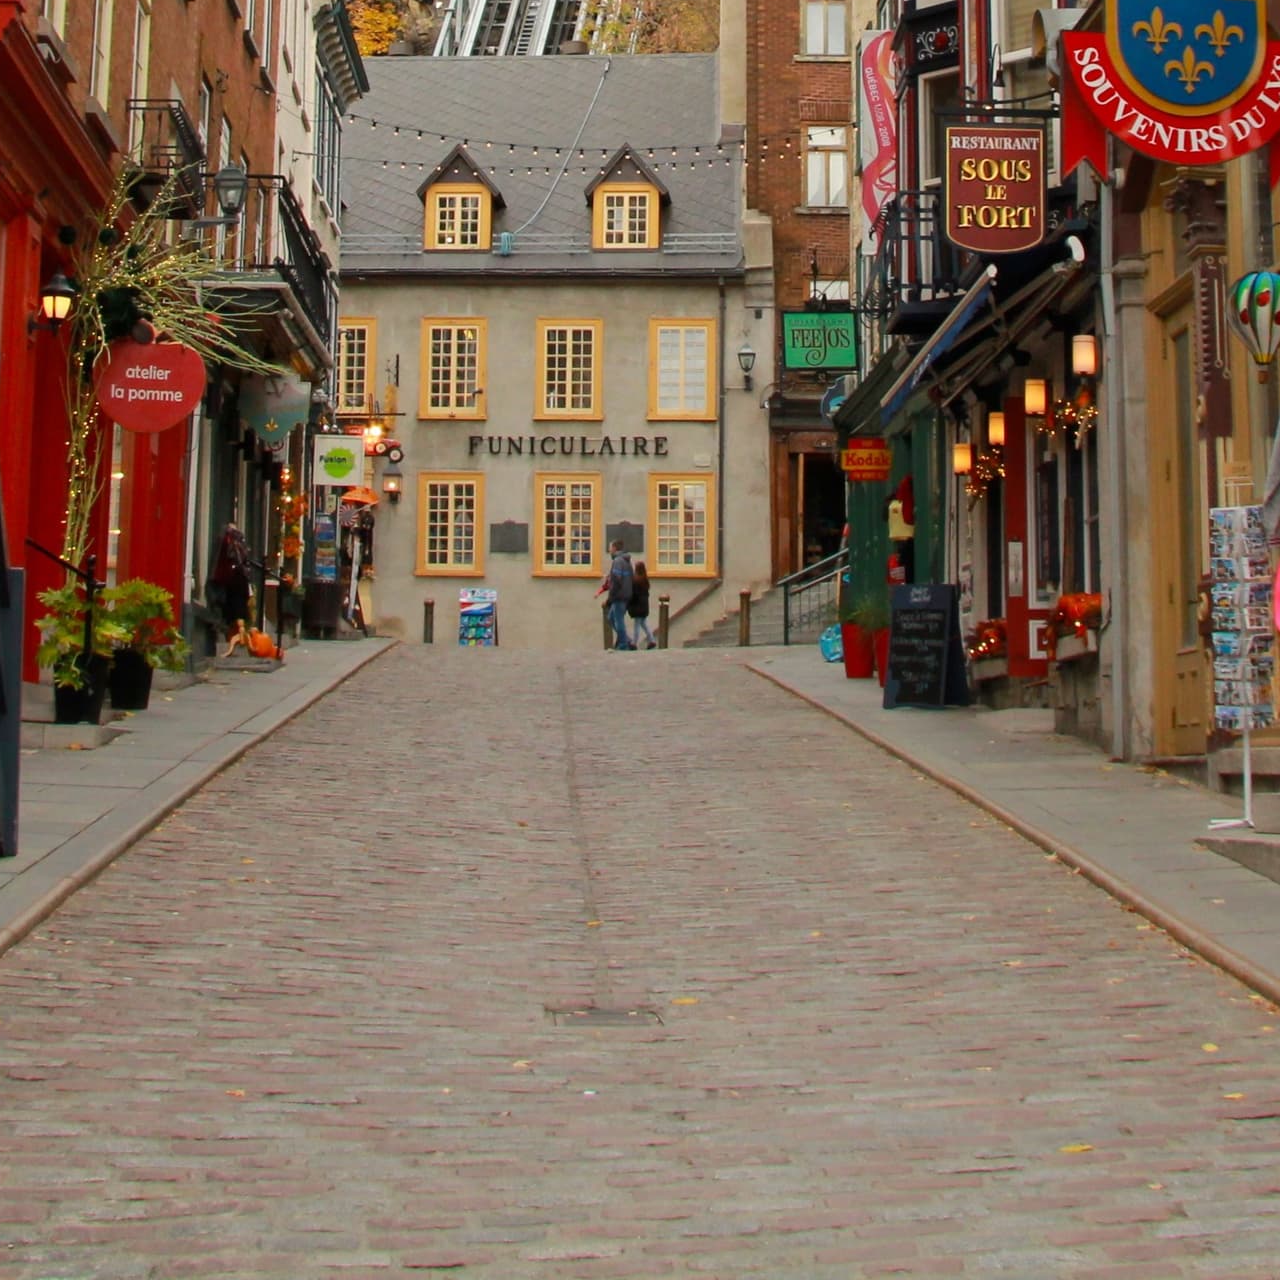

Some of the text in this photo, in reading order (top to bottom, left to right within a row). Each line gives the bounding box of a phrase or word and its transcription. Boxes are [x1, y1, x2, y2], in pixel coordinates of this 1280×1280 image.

[1074, 46, 1228, 153] SOUVENIRS
[1229, 106, 1266, 143] DU
[950, 135, 1040, 151] RESTAURANT
[961, 158, 1032, 181] SOUS
[984, 184, 1007, 201] LE
[956, 204, 1036, 229] FORT
[125, 364, 171, 380] atelier
[111, 384, 183, 403] la pomme
[468, 435, 670, 457] FUNICULAIRE
[845, 452, 889, 466] Kodak
